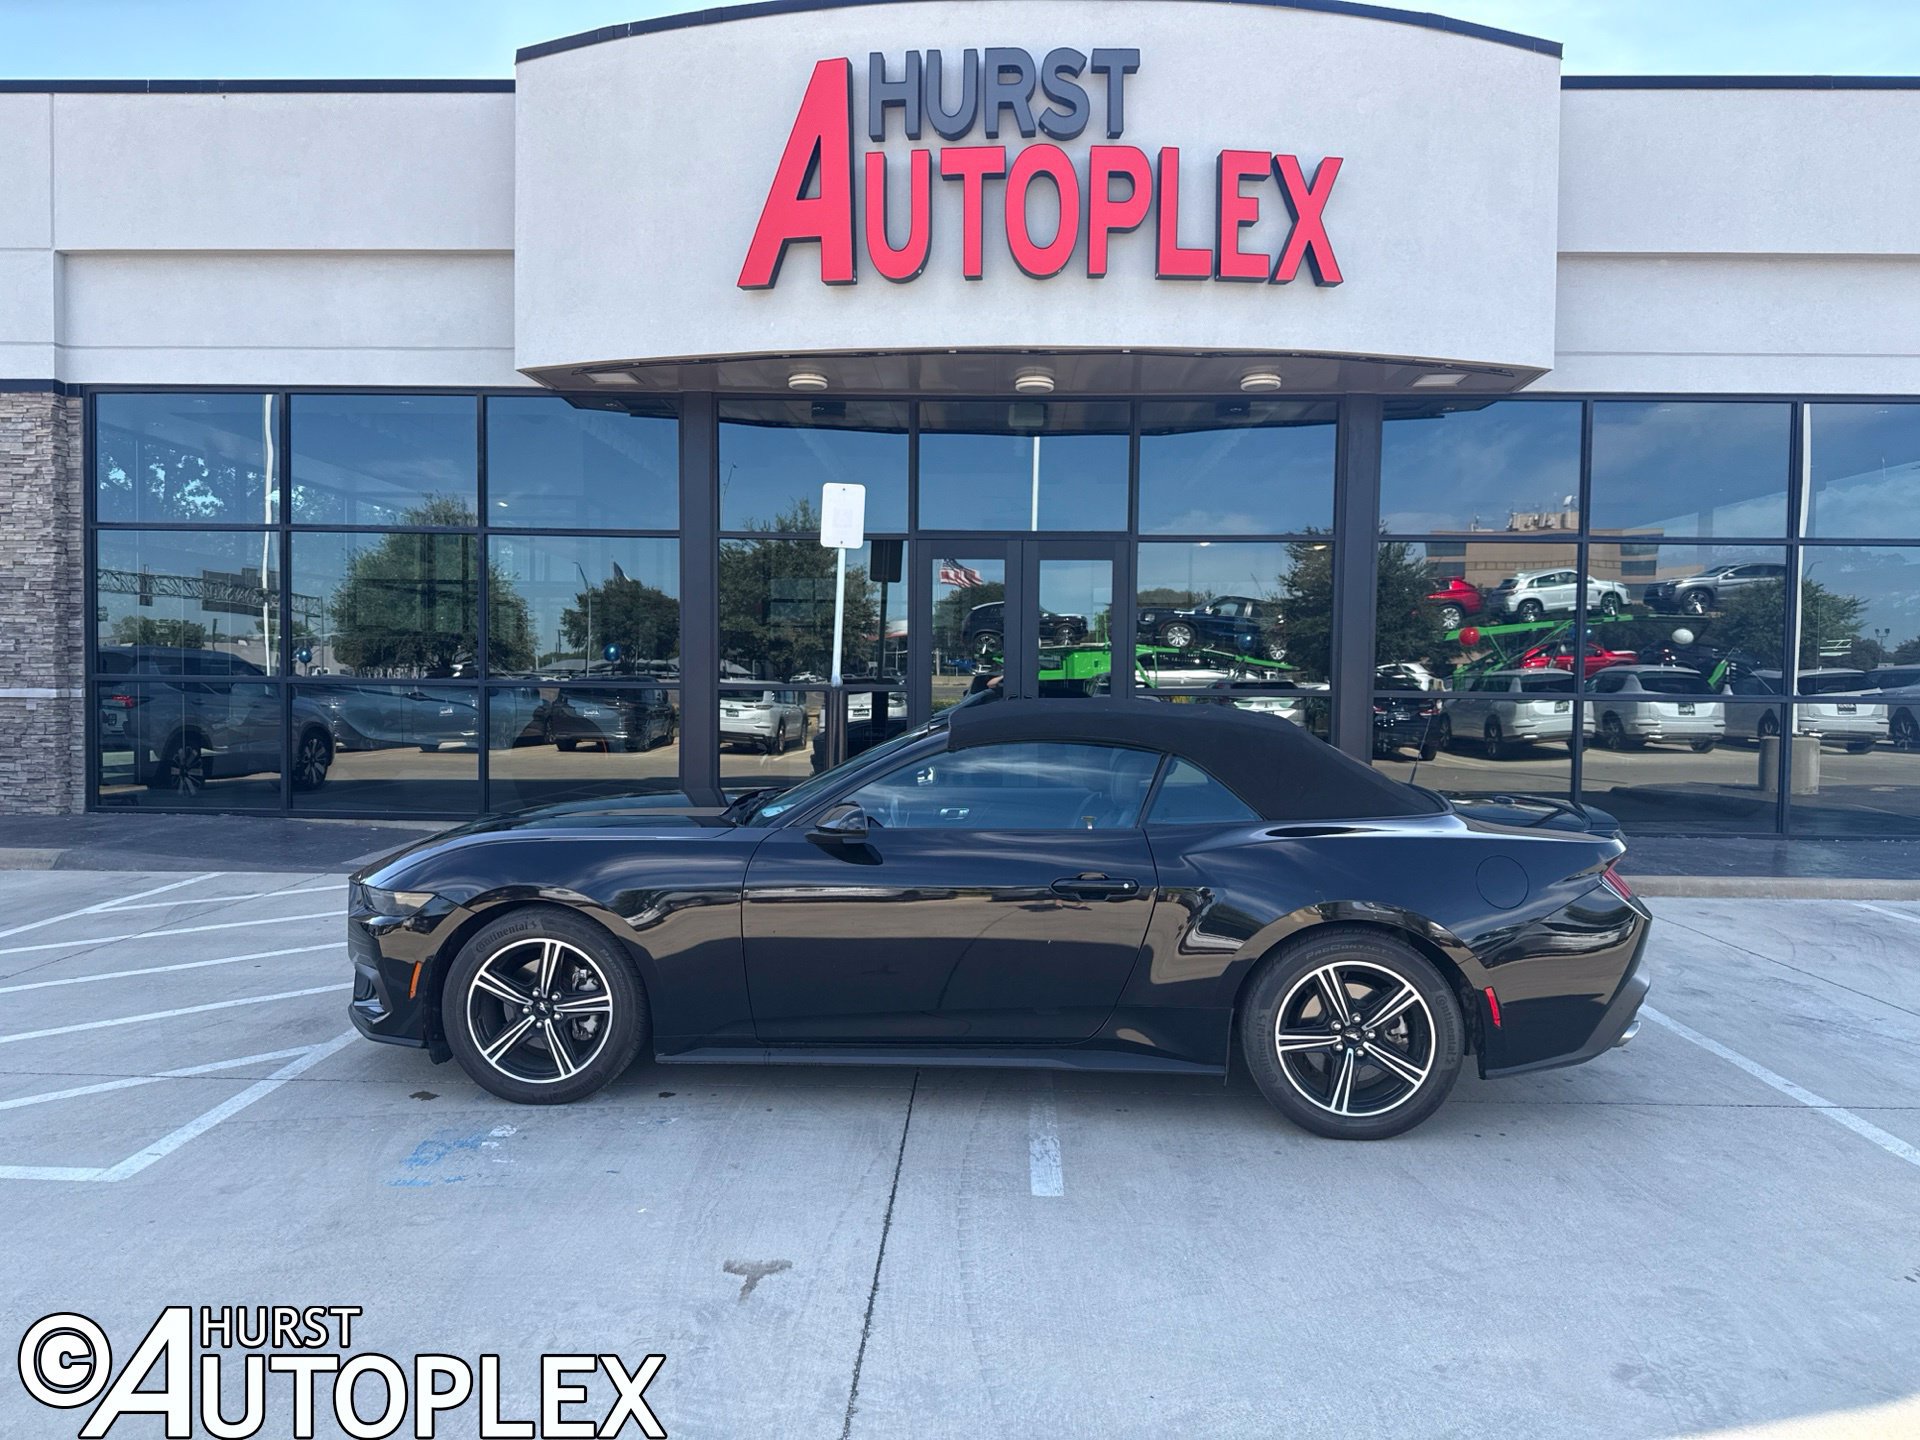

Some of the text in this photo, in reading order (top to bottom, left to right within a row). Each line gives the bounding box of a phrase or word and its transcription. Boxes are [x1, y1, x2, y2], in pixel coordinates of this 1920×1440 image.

[868, 47, 1140, 142] HURST
[737, 57, 1344, 290] AUTOPLEX
[475, 921, 529, 953] Continental
